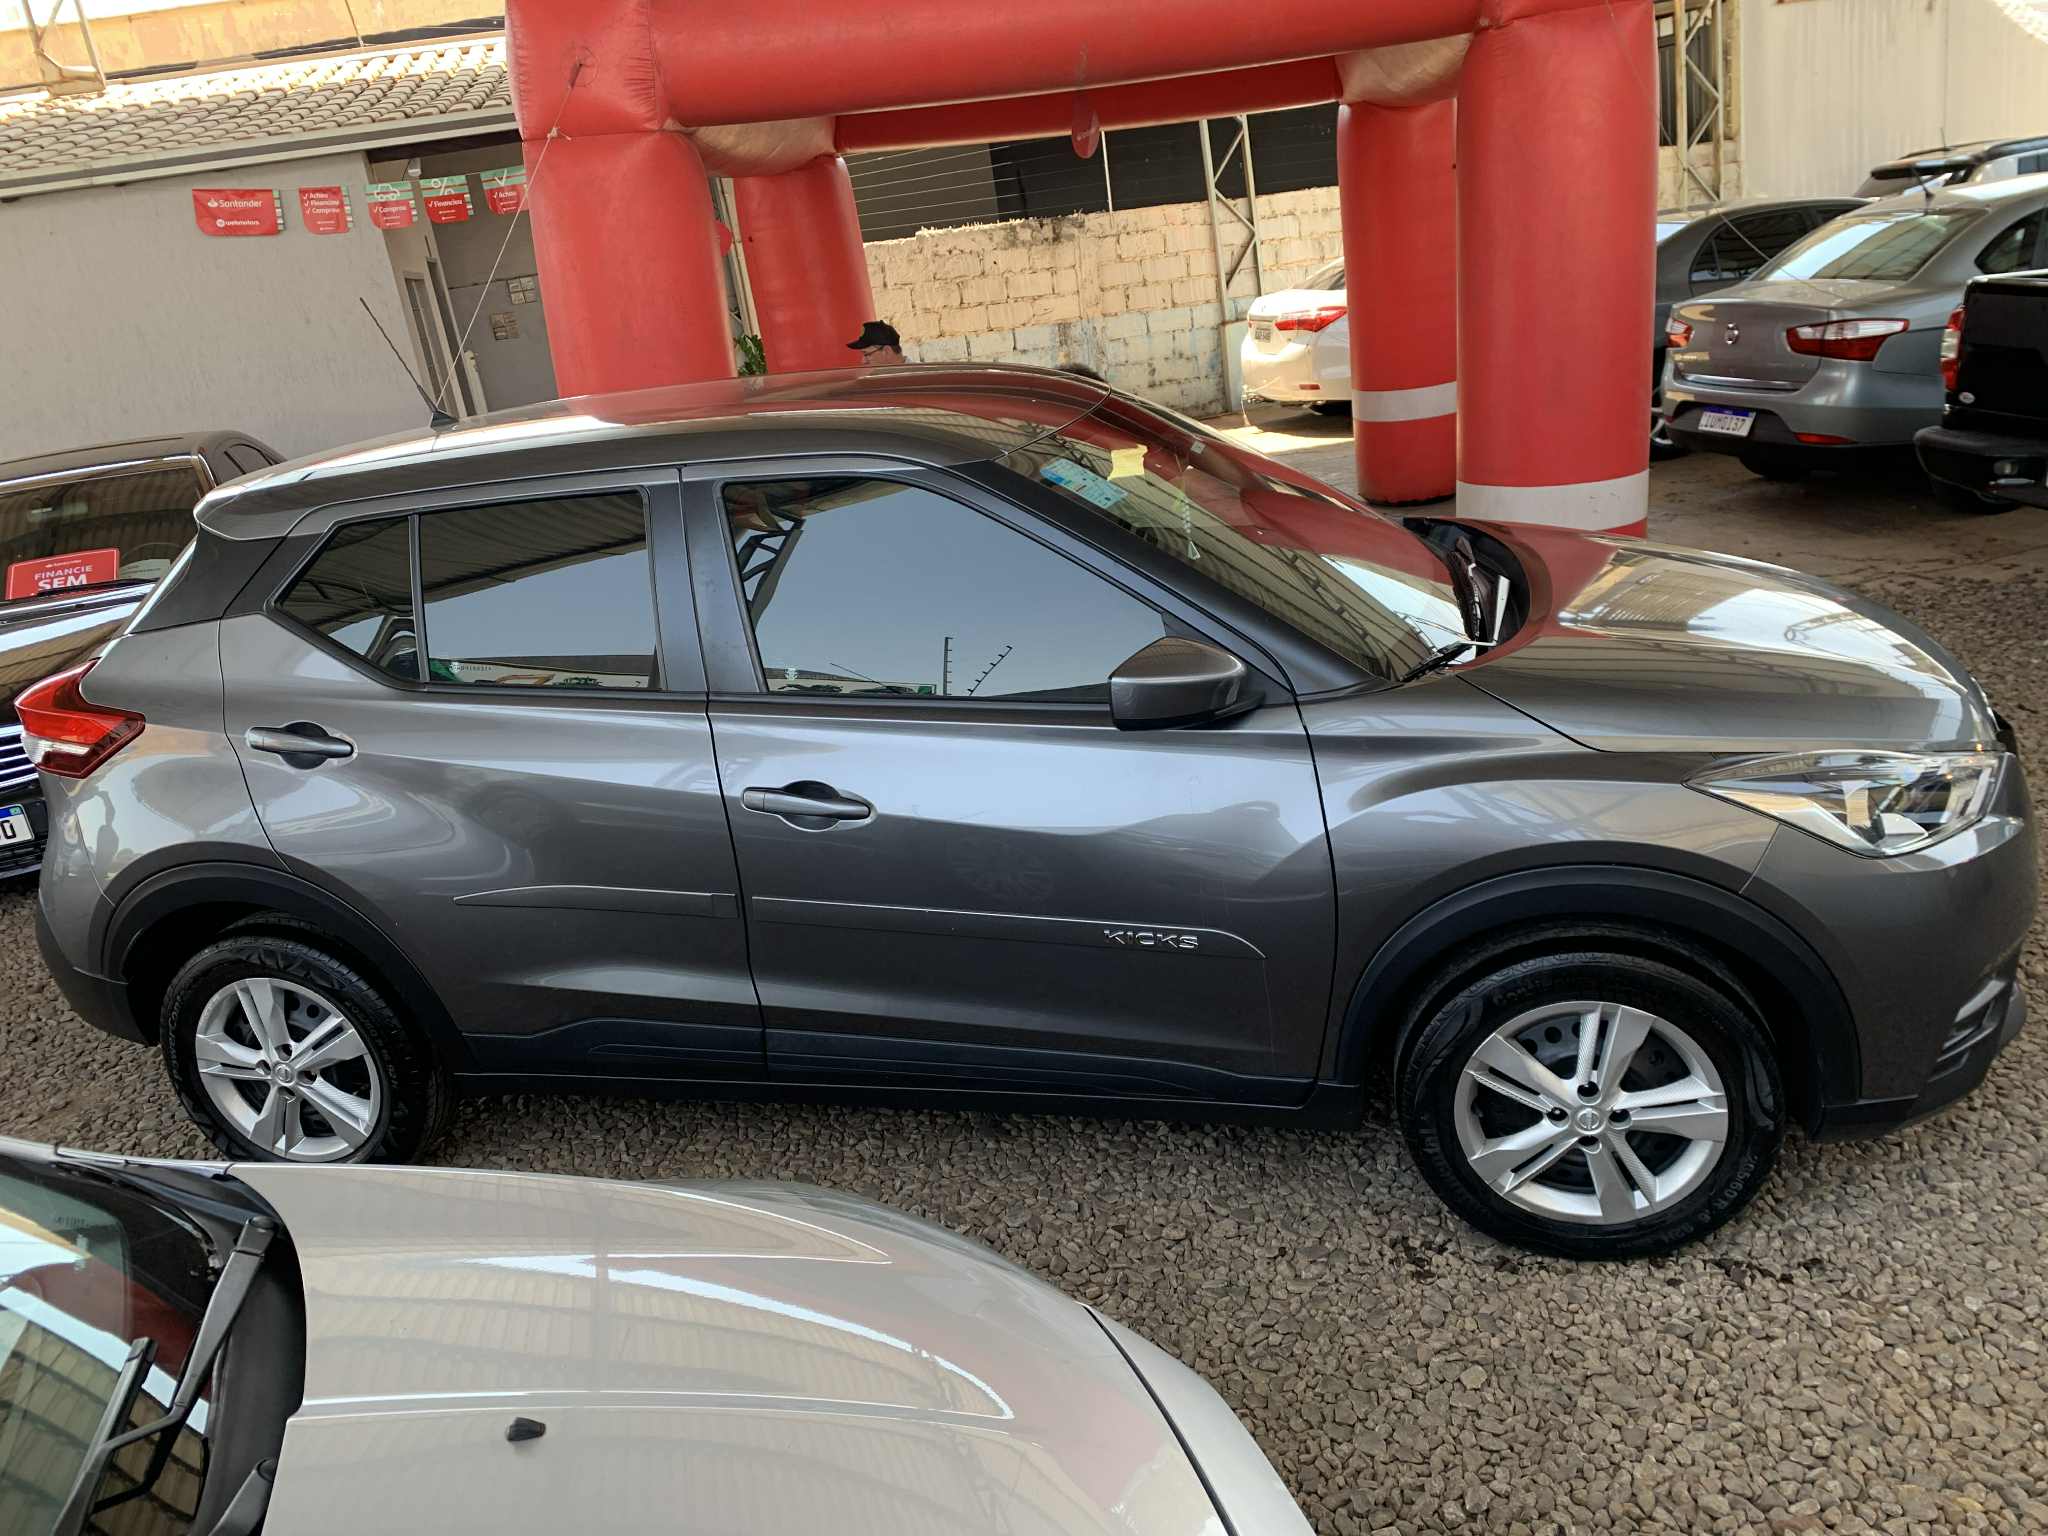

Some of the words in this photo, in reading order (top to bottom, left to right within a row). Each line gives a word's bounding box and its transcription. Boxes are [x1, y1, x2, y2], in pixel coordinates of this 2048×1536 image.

[219, 199, 263, 208] Santander
[34, 564, 93, 580] FINANCIE
[38, 574, 88, 591] SEM
[1103, 929, 1199, 949] KICKS
